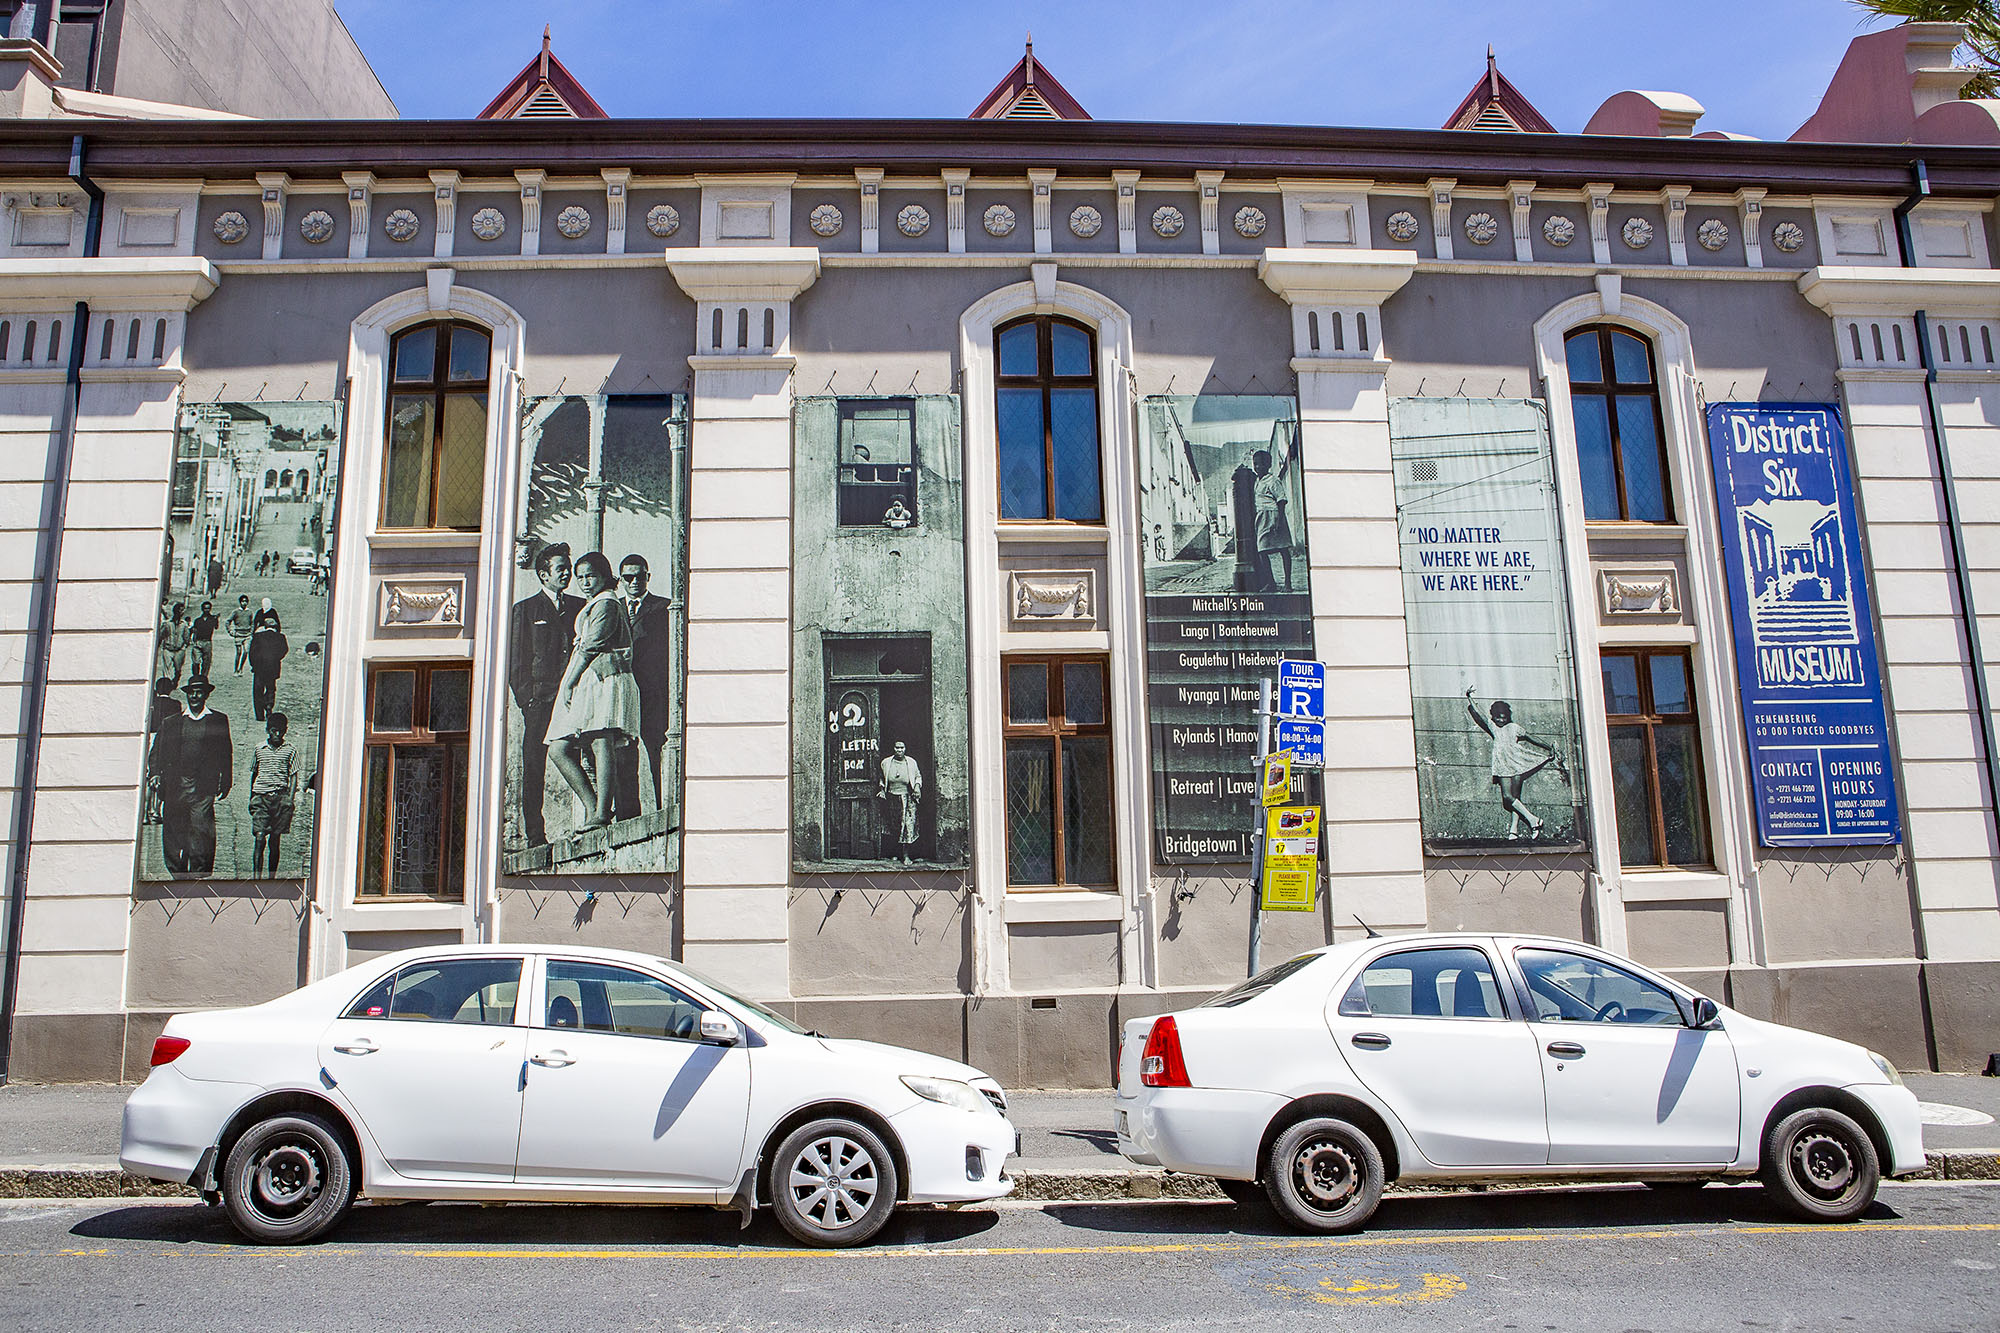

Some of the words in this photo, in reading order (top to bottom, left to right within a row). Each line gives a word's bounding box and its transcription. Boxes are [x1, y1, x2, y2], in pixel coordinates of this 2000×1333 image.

[1730, 415, 1824, 454] District
[1762, 458, 1802, 497] Six
[1444, 527, 1502, 544] MATTER
[1419, 551, 1471, 567] WHERE
[1475, 551, 1499, 567] WE
[1503, 551, 1536, 571] ARE,
[1422, 575, 1445, 591] WE
[1450, 575, 1479, 591] ARE
[1192, 599, 1237, 612] Mitchell’s
[1240, 599, 1265, 611] Plain
[1180, 624, 1209, 640] Langa
[1219, 622, 1279, 637] Bonteheuwel
[1179, 652, 1229, 669] Gugulethu
[1760, 646, 1855, 683] MUSEUM
[1290, 664, 1314, 676] TOUR
[1178, 687, 1219, 705] Nyanga
[1291, 691, 1312, 717] R
[843, 703, 866, 727] 2
[1754, 714, 1817, 724] REMEMBERING
[1173, 727, 1215, 746] Rylands
[1756, 726, 1767, 736] 60
[1771, 726, 1788, 736] 000
[1792, 726, 1825, 736] FORCED
[1829, 725, 1875, 735] GOODBYES
[844, 759, 865, 770] BOX
[1760, 762, 1813, 777] CONTACT
[1830, 761, 1882, 776] OPENING
[1170, 778, 1214, 795] Retreat
[1832, 780, 1875, 795] HOURS
[1835, 809, 1854, 819] 09:00
[1858, 809, 1875, 818] 16:00
[1166, 834, 1237, 856] Bridgetown
[1275, 844, 1285, 853] 17
